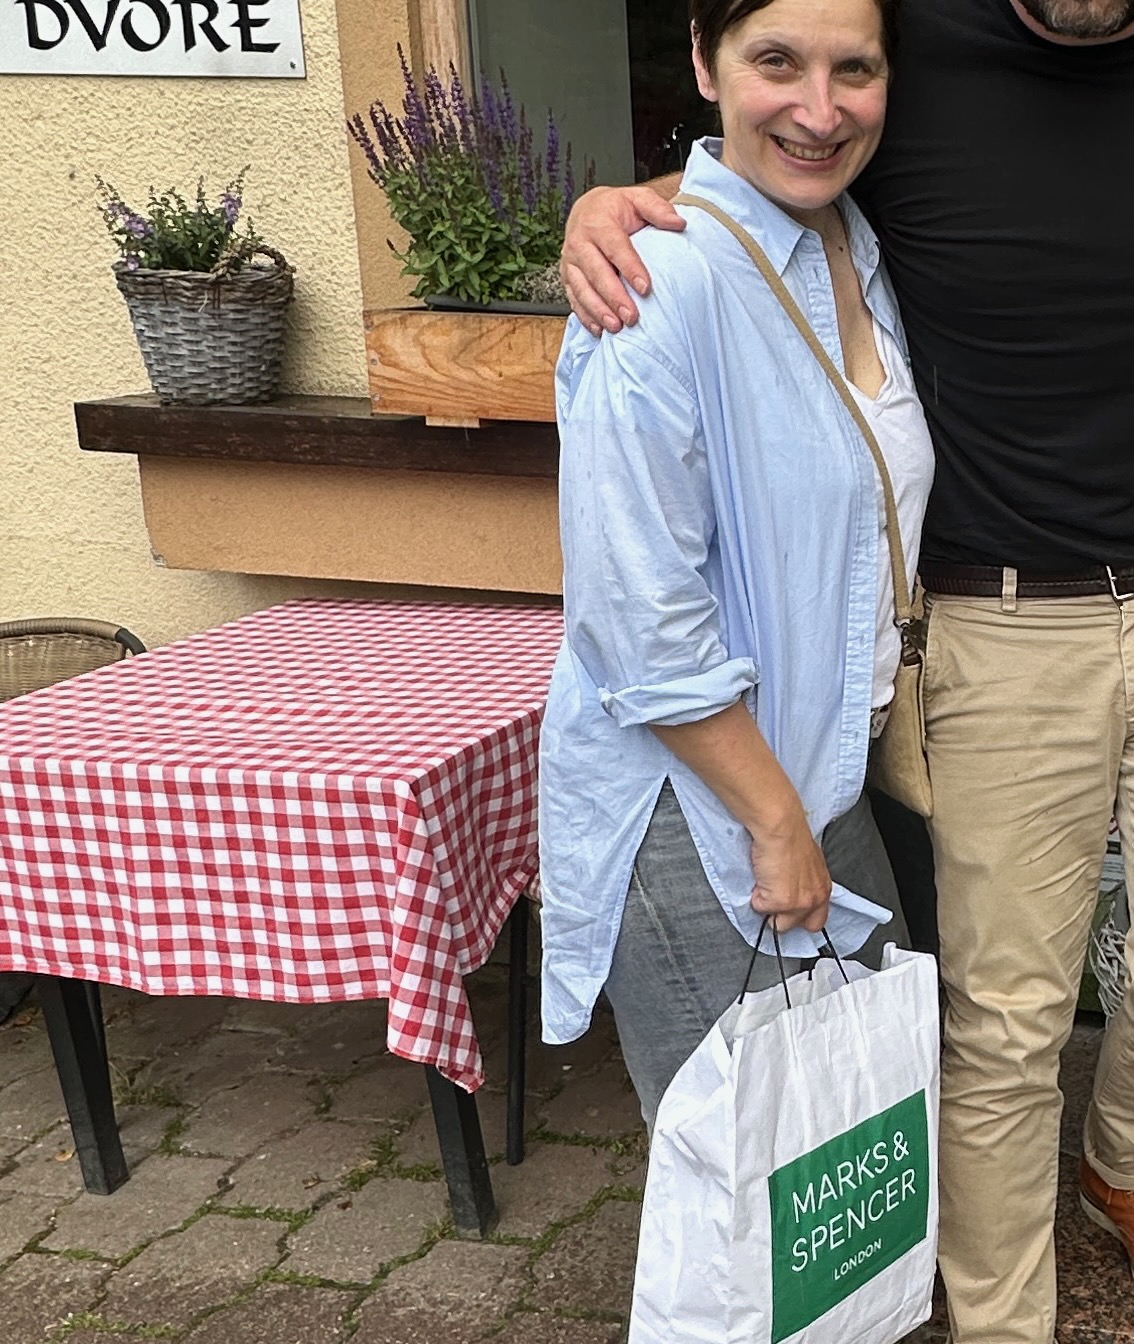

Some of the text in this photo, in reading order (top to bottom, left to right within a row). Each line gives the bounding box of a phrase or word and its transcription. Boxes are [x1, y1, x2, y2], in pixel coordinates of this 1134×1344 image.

[791, 1130, 910, 1223] MARKS &
[791, 1167, 916, 1273] SPENCER
[834, 1237, 883, 1281] LONDON
